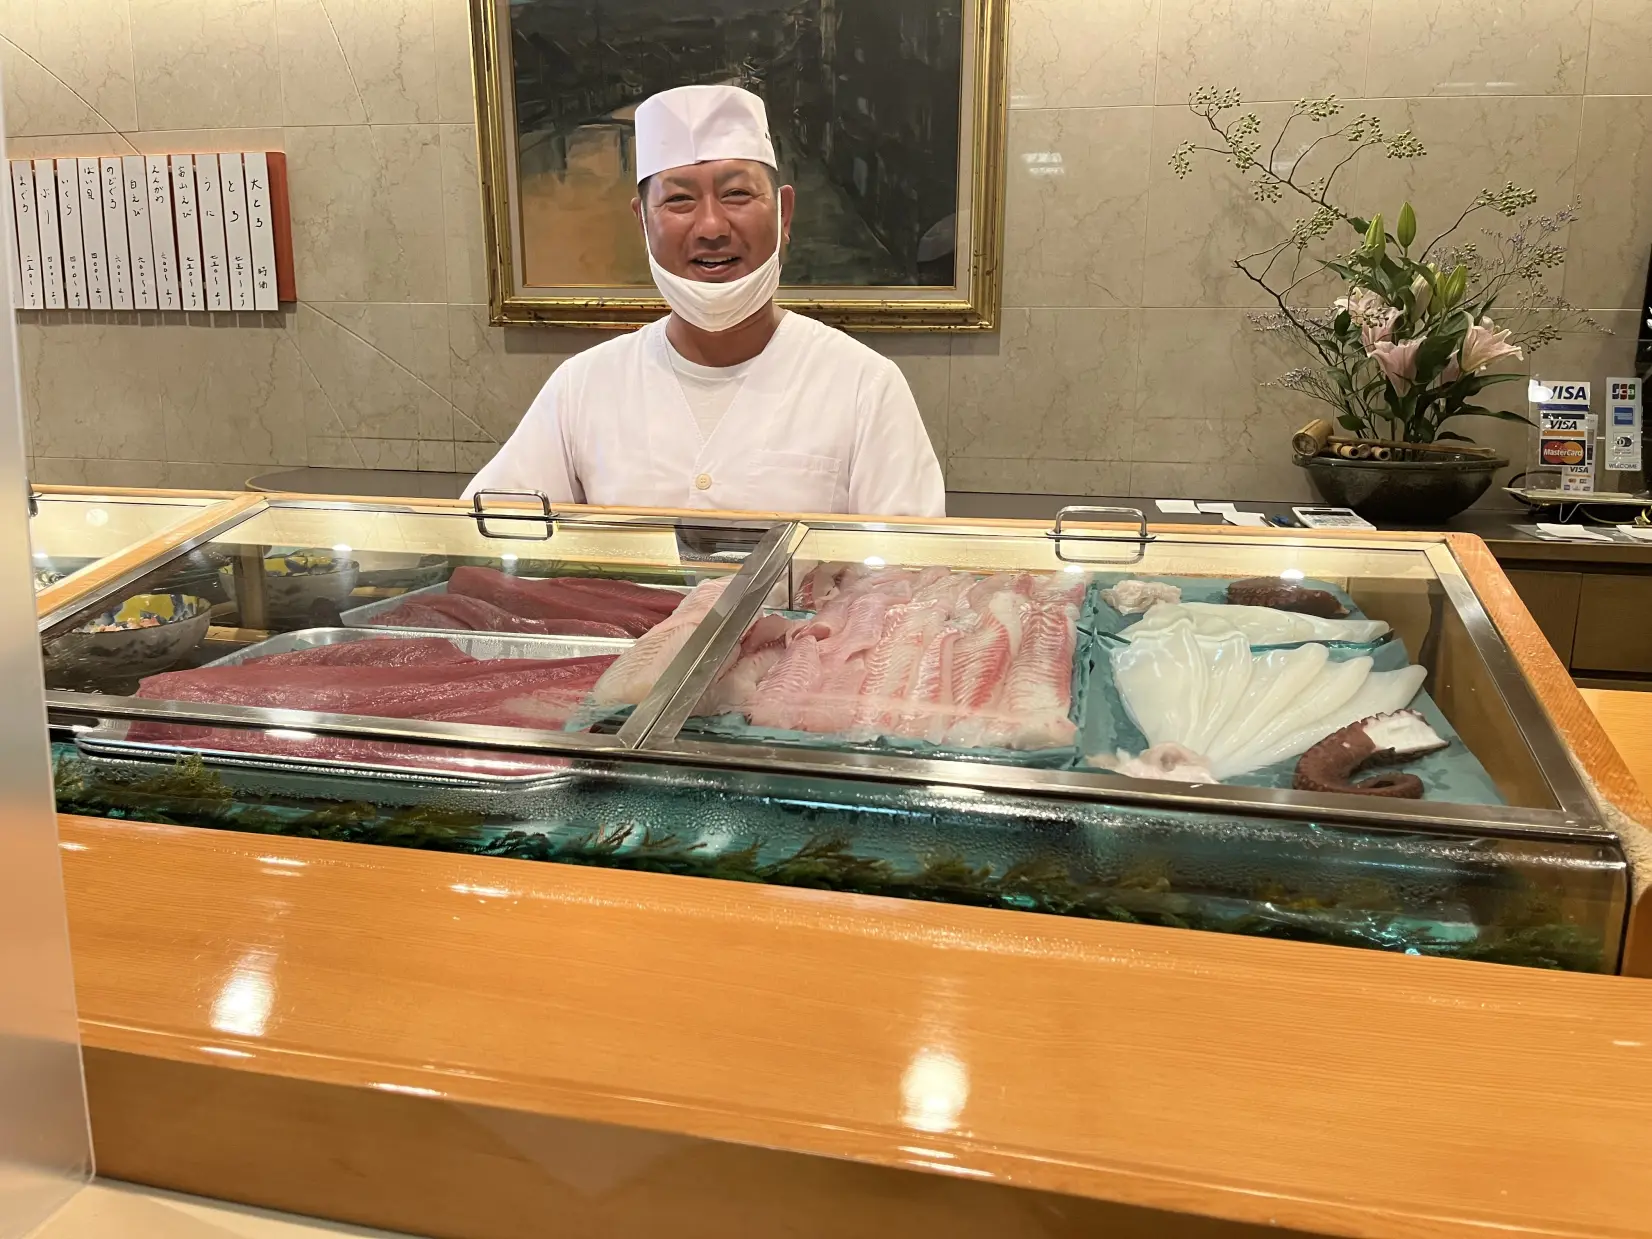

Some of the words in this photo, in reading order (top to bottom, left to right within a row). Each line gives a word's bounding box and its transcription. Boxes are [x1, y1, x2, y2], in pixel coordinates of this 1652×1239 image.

[61, 179, 72, 215] いくら
[106, 166, 117, 209] のどぐろ
[204, 177, 215, 216] うに
[228, 180, 239, 222] とろ
[250, 179, 263, 227] 大とろ
[1549, 420, 1577, 430] VISA
[1543, 448, 1583, 457] MasterCard
